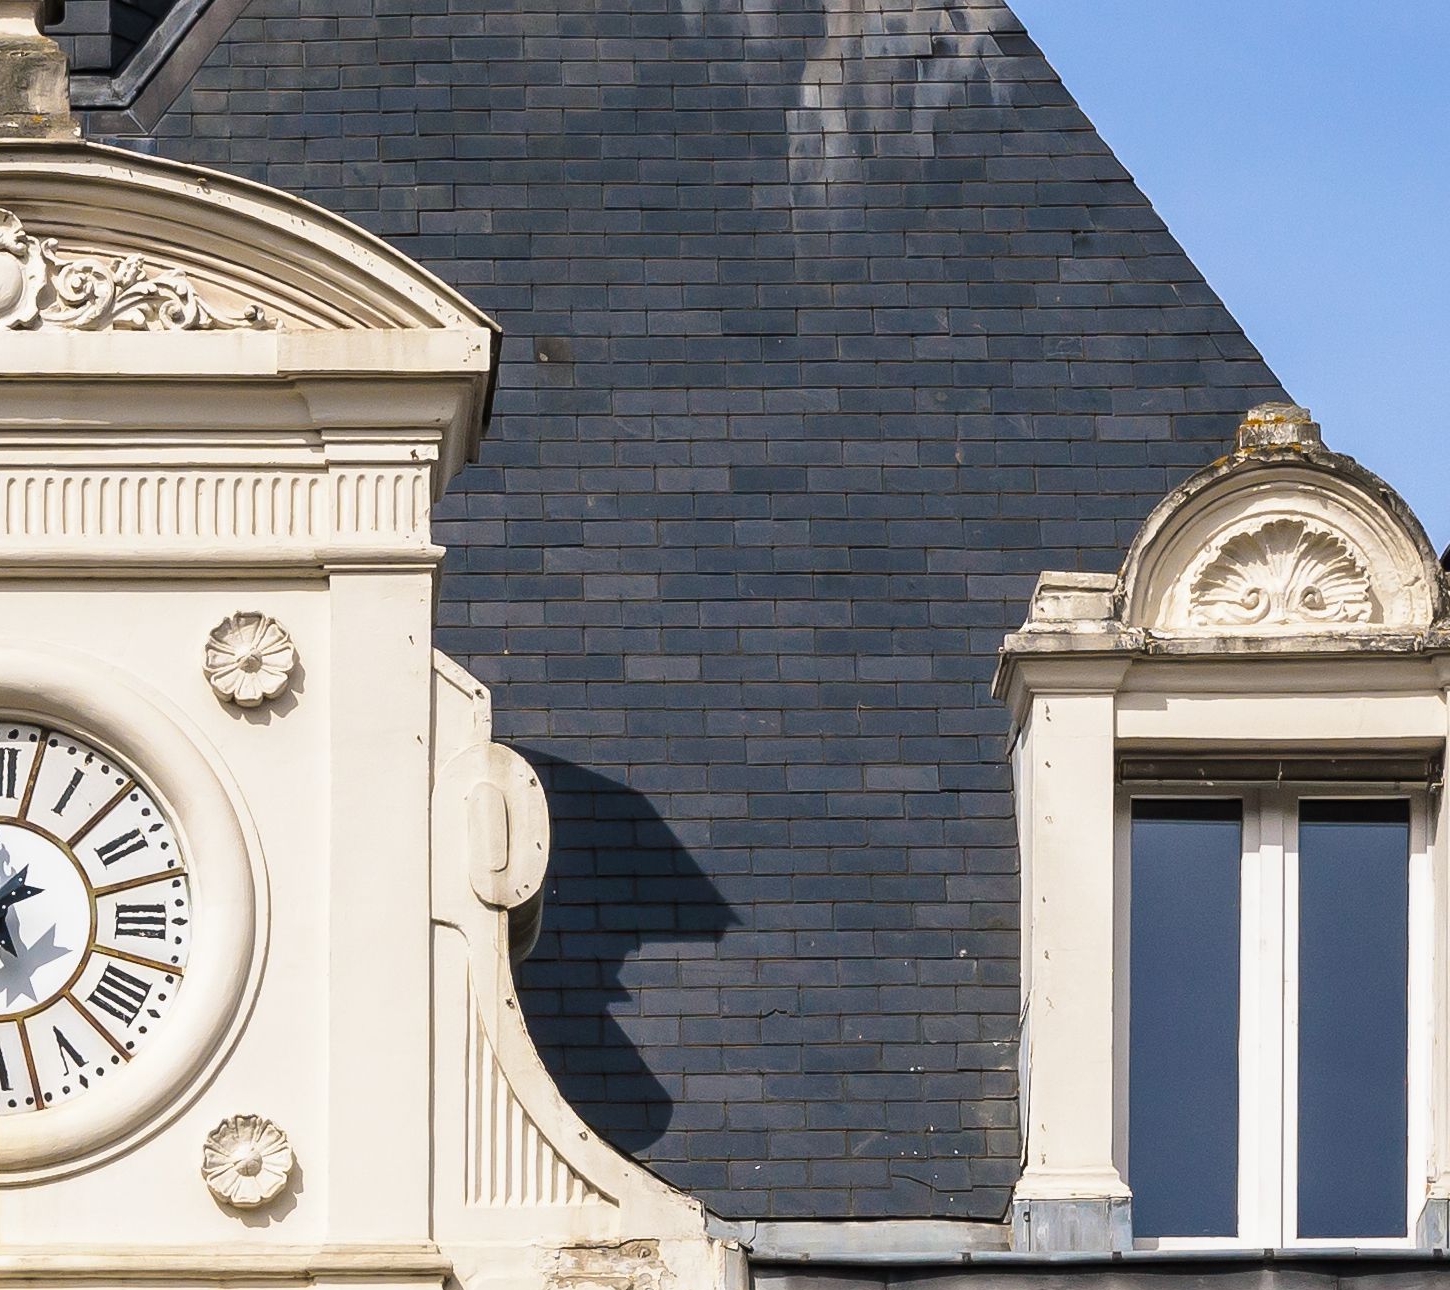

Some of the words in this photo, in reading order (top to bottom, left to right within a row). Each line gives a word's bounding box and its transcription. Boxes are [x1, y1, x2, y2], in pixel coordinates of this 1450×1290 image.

[51, 767, 85, 817] I
[94, 827, 149, 870] II
[114, 901, 167, 941] III
[85, 962, 153, 1028] IIII
[53, 1026, 90, 1077] V
